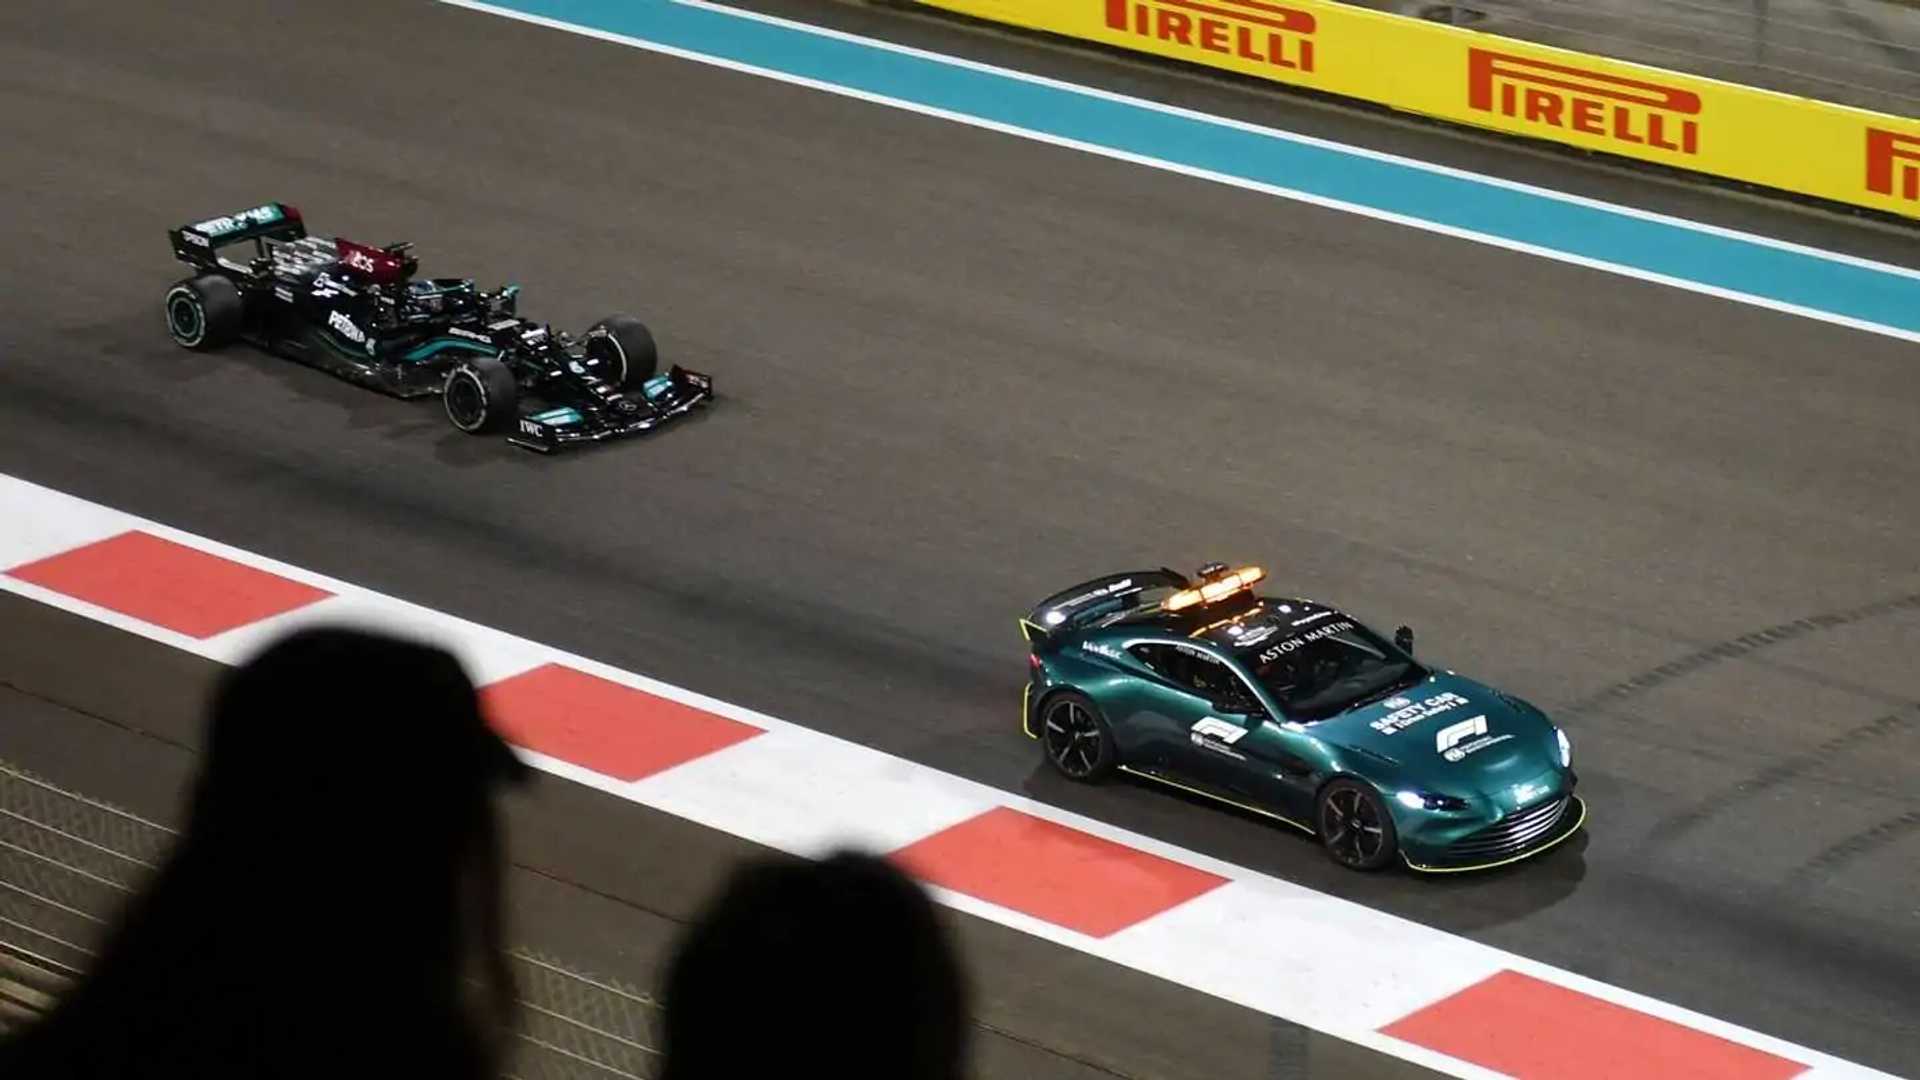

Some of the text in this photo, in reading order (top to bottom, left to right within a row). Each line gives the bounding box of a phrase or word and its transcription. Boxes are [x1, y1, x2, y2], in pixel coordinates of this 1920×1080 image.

[1468, 47, 1702, 155] PIRELLI
[520, 419, 544, 437] IWC
[1260, 637, 1305, 664] ASTON
[1304, 621, 1355, 642] MARTIN
[1369, 702, 1426, 731] SAFETY
[1424, 691, 1460, 707] CAR
